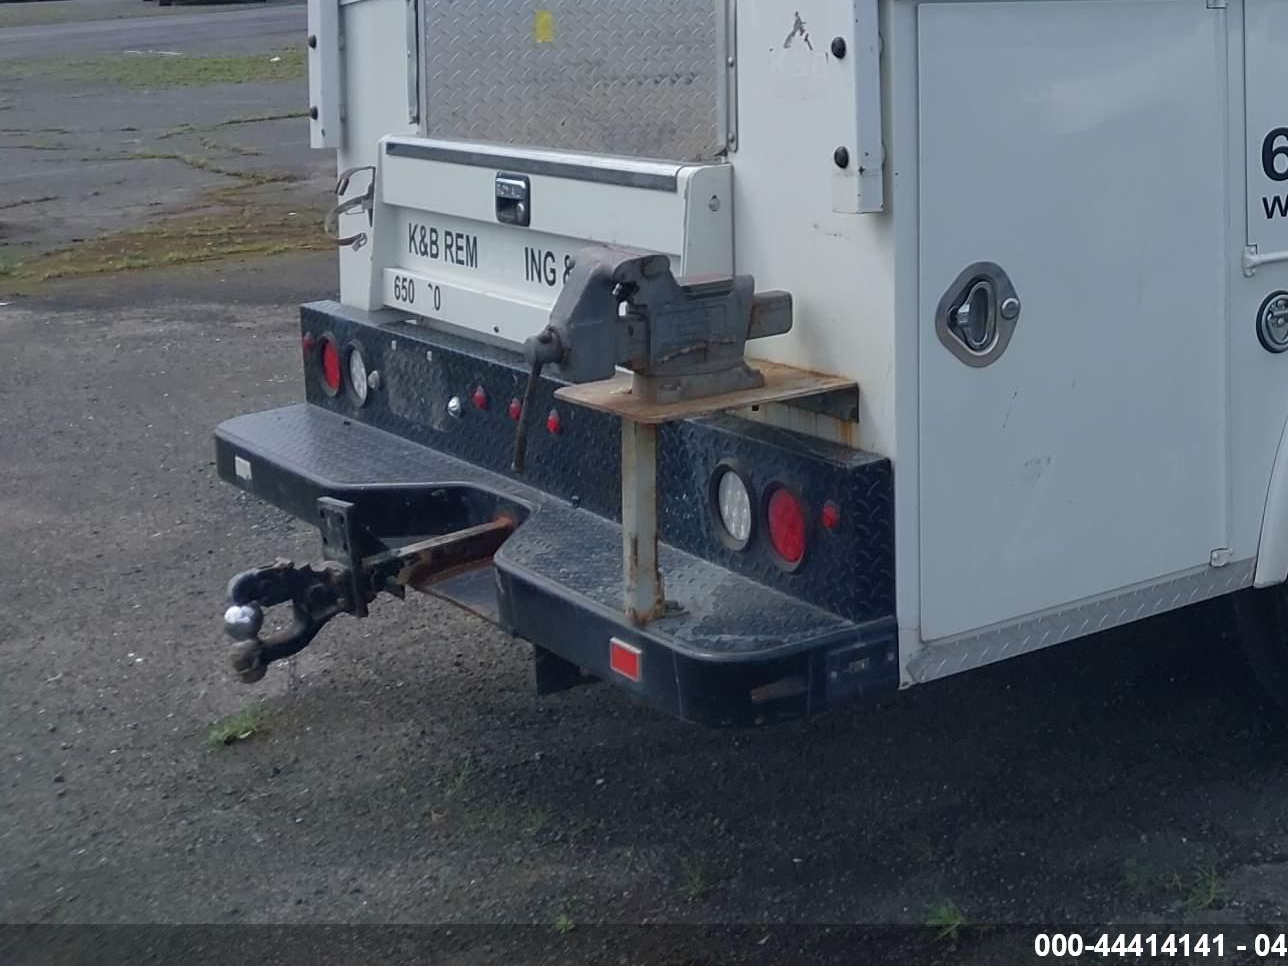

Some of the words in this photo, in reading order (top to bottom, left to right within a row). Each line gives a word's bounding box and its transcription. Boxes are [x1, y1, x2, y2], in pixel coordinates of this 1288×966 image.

[408, 223, 440, 260] K&B
[444, 231, 479, 269] REM
[524, 247, 557, 286] ING
[394, 275, 415, 304] 650
